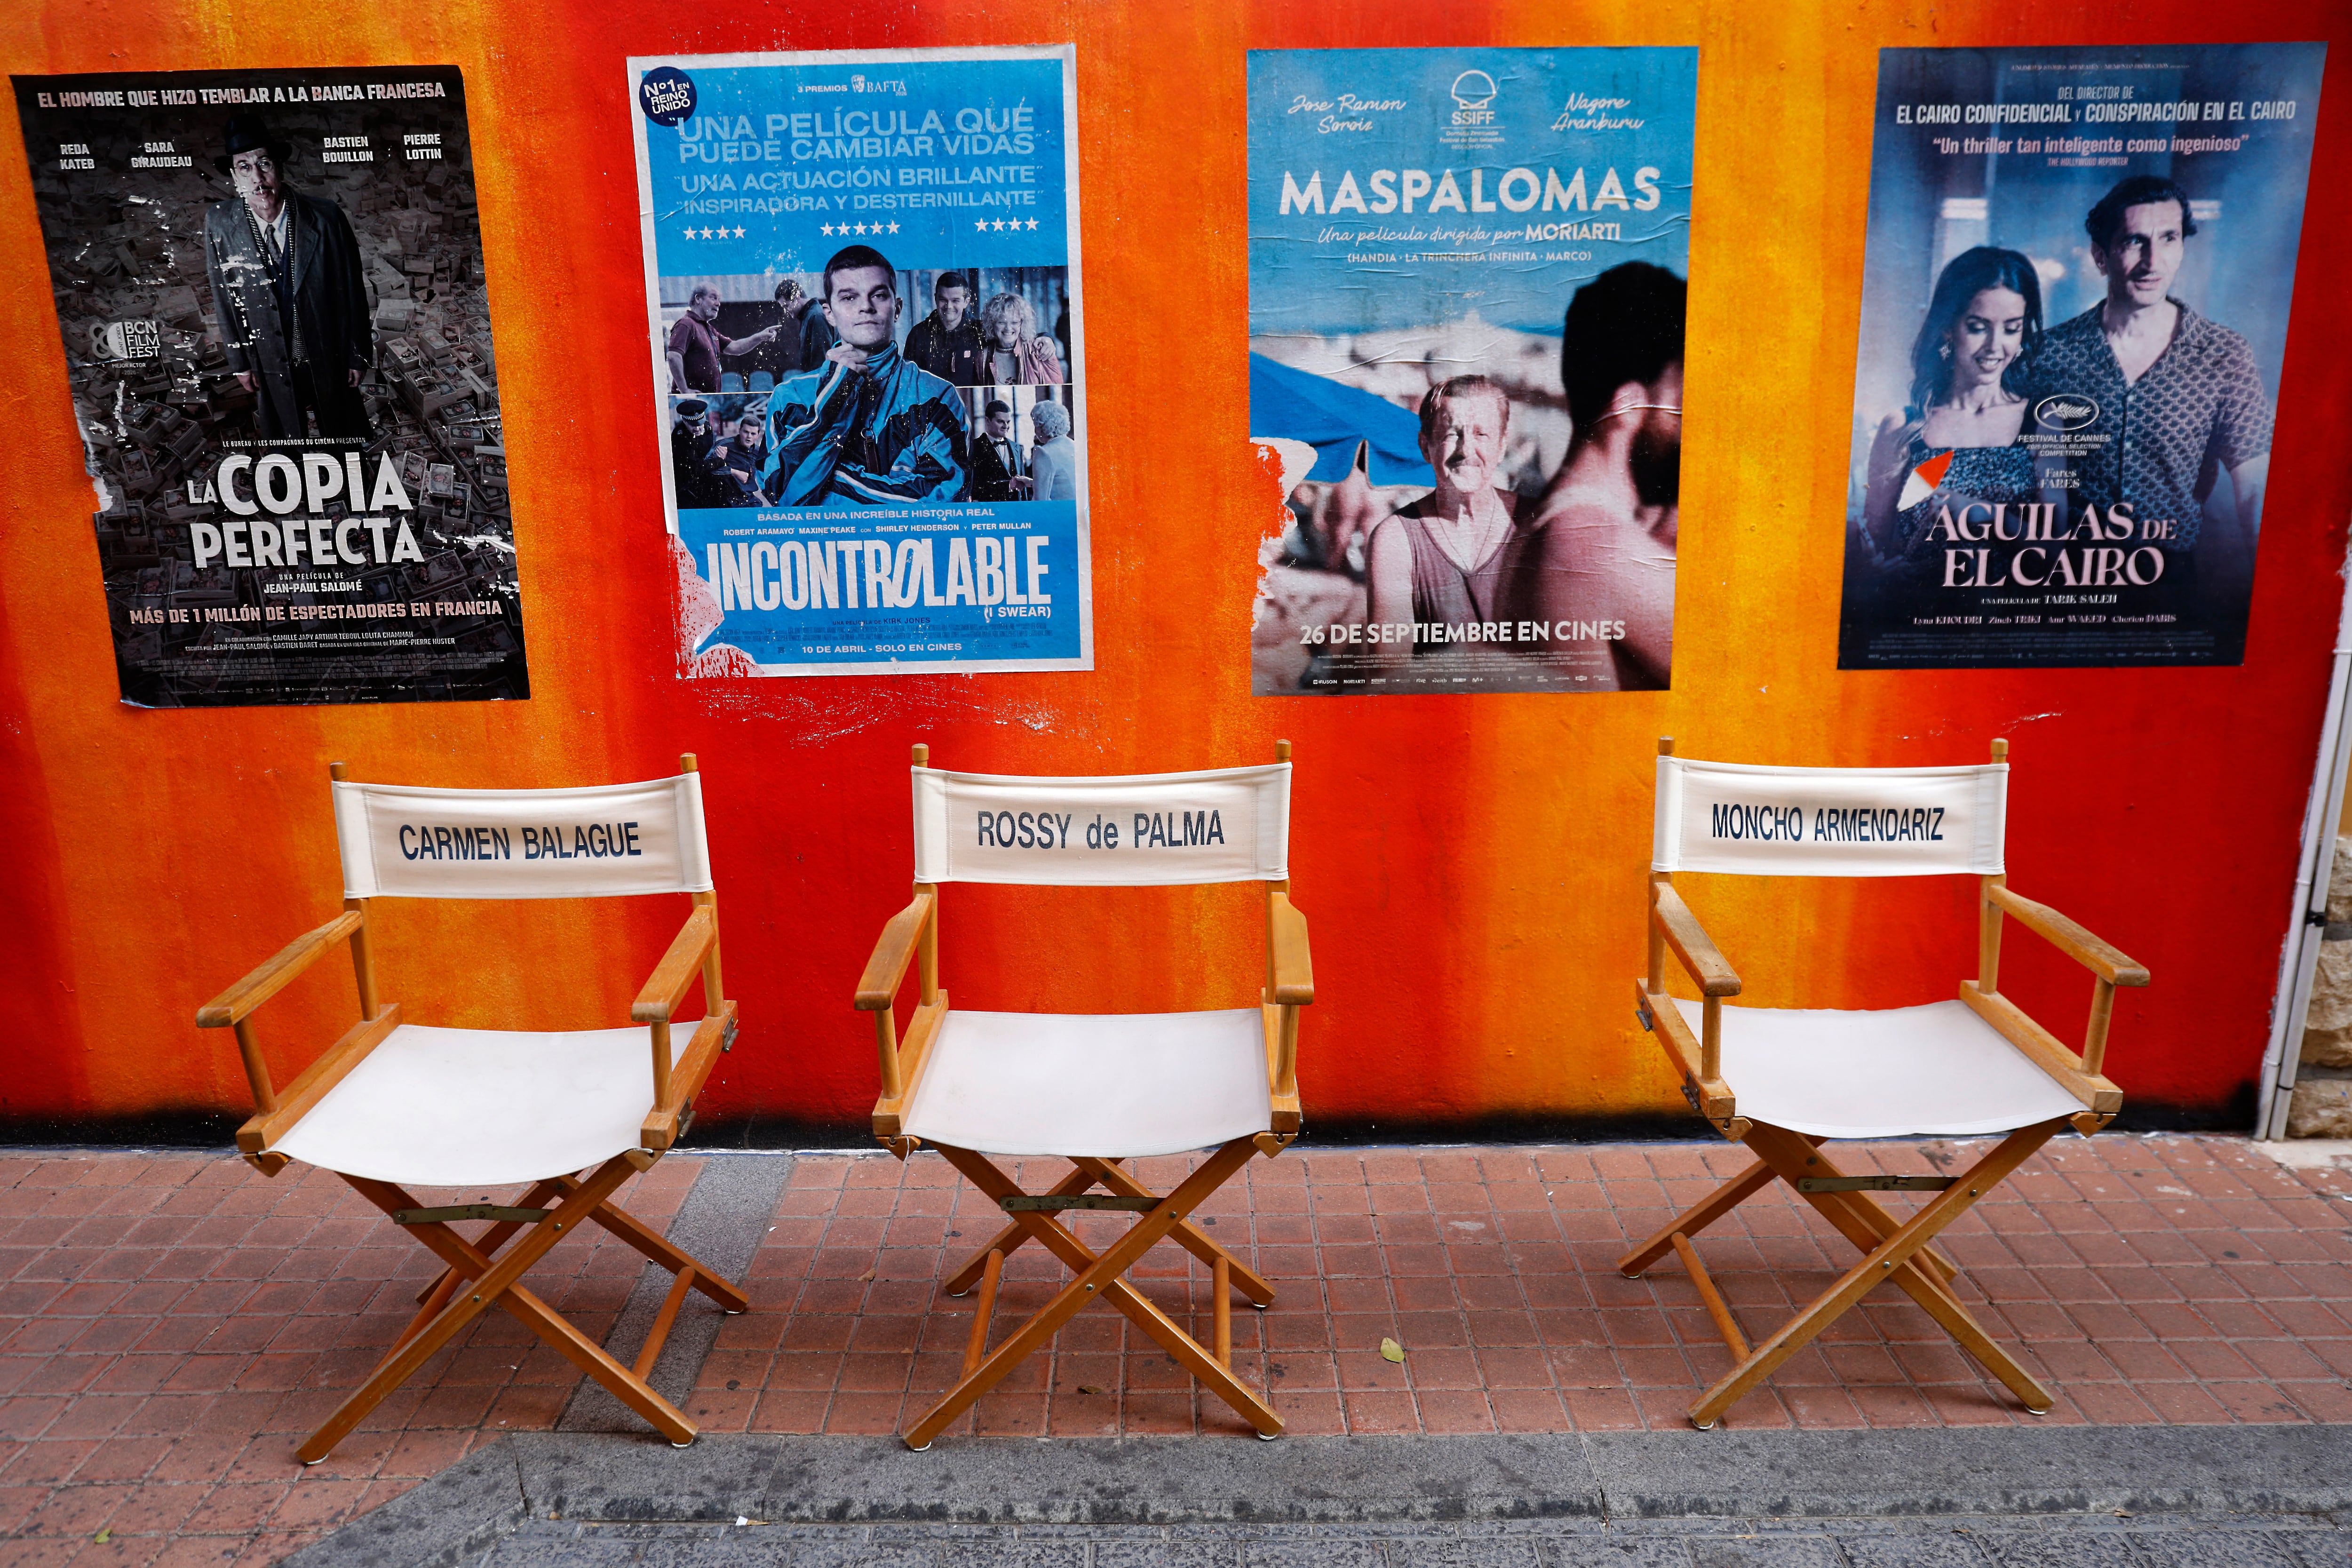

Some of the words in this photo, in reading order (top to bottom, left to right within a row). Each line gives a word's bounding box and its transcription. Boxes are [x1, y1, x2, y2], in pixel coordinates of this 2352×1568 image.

[867, 81, 906, 93] BAFTA
[2058, 87, 2074, 100] DEL
[2077, 86, 2120, 100] DIRECTOR
[2122, 86, 2134, 99] DE
[38, 93, 57, 107] EL
[59, 91, 125, 107] HOMBRE
[128, 90, 158, 107] QUE
[161, 89, 197, 105] HIZO
[199, 88, 270, 104] TEMBLAR
[274, 87, 286, 102] A
[288, 86, 309, 101] LA
[311, 85, 365, 101] BANCA
[367, 82, 445, 99] FRANCESA
[651, 90, 687, 105] REINO
[652, 98, 690, 113] UNIDO
[1287, 95, 1334, 114] Jose
[1338, 94, 1406, 113] Ramon
[1565, 92, 1631, 116] Nagore
[1452, 111, 1495, 125] SSIFF
[1896, 105, 1913, 124] EL
[1916, 104, 1961, 124] CAIRO
[1964, 103, 2071, 124] CONFIDENCIAL
[2085, 100, 2200, 123] CONSPIRACIÓN
[2203, 102, 2225, 121] EN
[2229, 102, 2245, 120] EL
[2251, 101, 2296, 120] CAIRO
[766, 106, 946, 138] PELÍCULA
[1318, 115, 1373, 134] Soroiz
[1551, 112, 1645, 131] Aranburu
[324, 136, 368, 148] BASTIEN
[404, 134, 441, 145] PIERRE
[1963, 137, 2013, 154] thriller
[2017, 138, 2041, 153] tan
[2044, 136, 2123, 156] inteligente
[2127, 139, 2167, 153] como
[60, 144, 89, 154] REDA
[144, 142, 175, 152] SARA
[405, 148, 442, 160] LOTTIN
[679, 140, 782, 163] PUEDE
[791, 135, 933, 160] CAMBIAR
[60, 159, 95, 169] KATEB
[131, 156, 192, 167] GIRAUDEAU
[323, 151, 373, 163] BOUILLON
[2048, 157, 2058, 166] THE
[2060, 157, 2097, 166] HOLLYWOOD
[2098, 157, 2128, 166] REPORTER
[742, 166, 891, 191] ACTUACIÓN
[1279, 167, 1661, 215] MASPALOMAS
[834, 195, 848, 210] Y
[1318, 227, 1354, 244] Una
[1356, 226, 1428, 247] película
[1430, 225, 1490, 246] dirigida
[1492, 231, 1525, 246] por
[1526, 223, 1620, 241] MORIARTI
[1348, 253, 1397, 263] (HANDIA
[1406, 254, 1419, 262] LA
[1422, 253, 1486, 262] TRINCHERA
[1489, 252, 1537, 261] INFINITA
[1546, 251, 1591, 262] MARCO)
[124, 321, 158, 334] BCN
[127, 334, 160, 346] FILM
[128, 346, 160, 358] FEST
[2018, 434, 2058, 443] FESTIVAL
[2046, 468, 2077, 478] Fares
[188, 480, 217, 504] LA
[218, 450, 414, 515] COPIA
[2040, 478, 2080, 489] FARES
[757, 512, 803, 521] BASADA
[850, 509, 908, 519] INCREÍBLE
[912, 509, 963, 517] HISTORIA
[1925, 494, 2134, 541] ÁGUILAS
[2141, 519, 2177, 540] DE
[189, 517, 425, 569] PERFECTA
[1941, 549, 2007, 587] EL
[2011, 546, 2164, 586] CAIRO
[297, 572, 331, 580] PELÍCULA
[264, 582, 319, 593] JEAN-PAUL
[321, 579, 362, 592] SALOMÉ
[2044, 595, 2077, 604] TARIK
[2079, 595, 2118, 604] SALEH
[130, 606, 164, 624] MÁS
[169, 609, 189, 623] DE
[193, 609, 200, 622] 1
[205, 604, 261, 622] MILLÓN
[265, 606, 285, 621] DE
[289, 604, 406, 620] ESPECTADORES
[411, 602, 430, 617] EN
[435, 600, 502, 616] FRANCIA
[998, 606, 1051, 619] SWEAR)
[1299, 624, 1325, 645] 26
[1331, 624, 1362, 644] DE
[1367, 621, 1512, 644] SEPTIEMBRE
[1518, 621, 1549, 641] EN
[1555, 620, 1626, 641] CINES
[978, 811, 1072, 849] ROSSY
[1086, 814, 1119, 850] de
[1134, 810, 1224, 848] PALMA
[1713, 804, 1803, 842] MONCHO
[1814, 807, 1946, 842] ARMENDARIZ
[399, 824, 510, 860] CARMEN
[522, 821, 641, 860] BALAGUE
